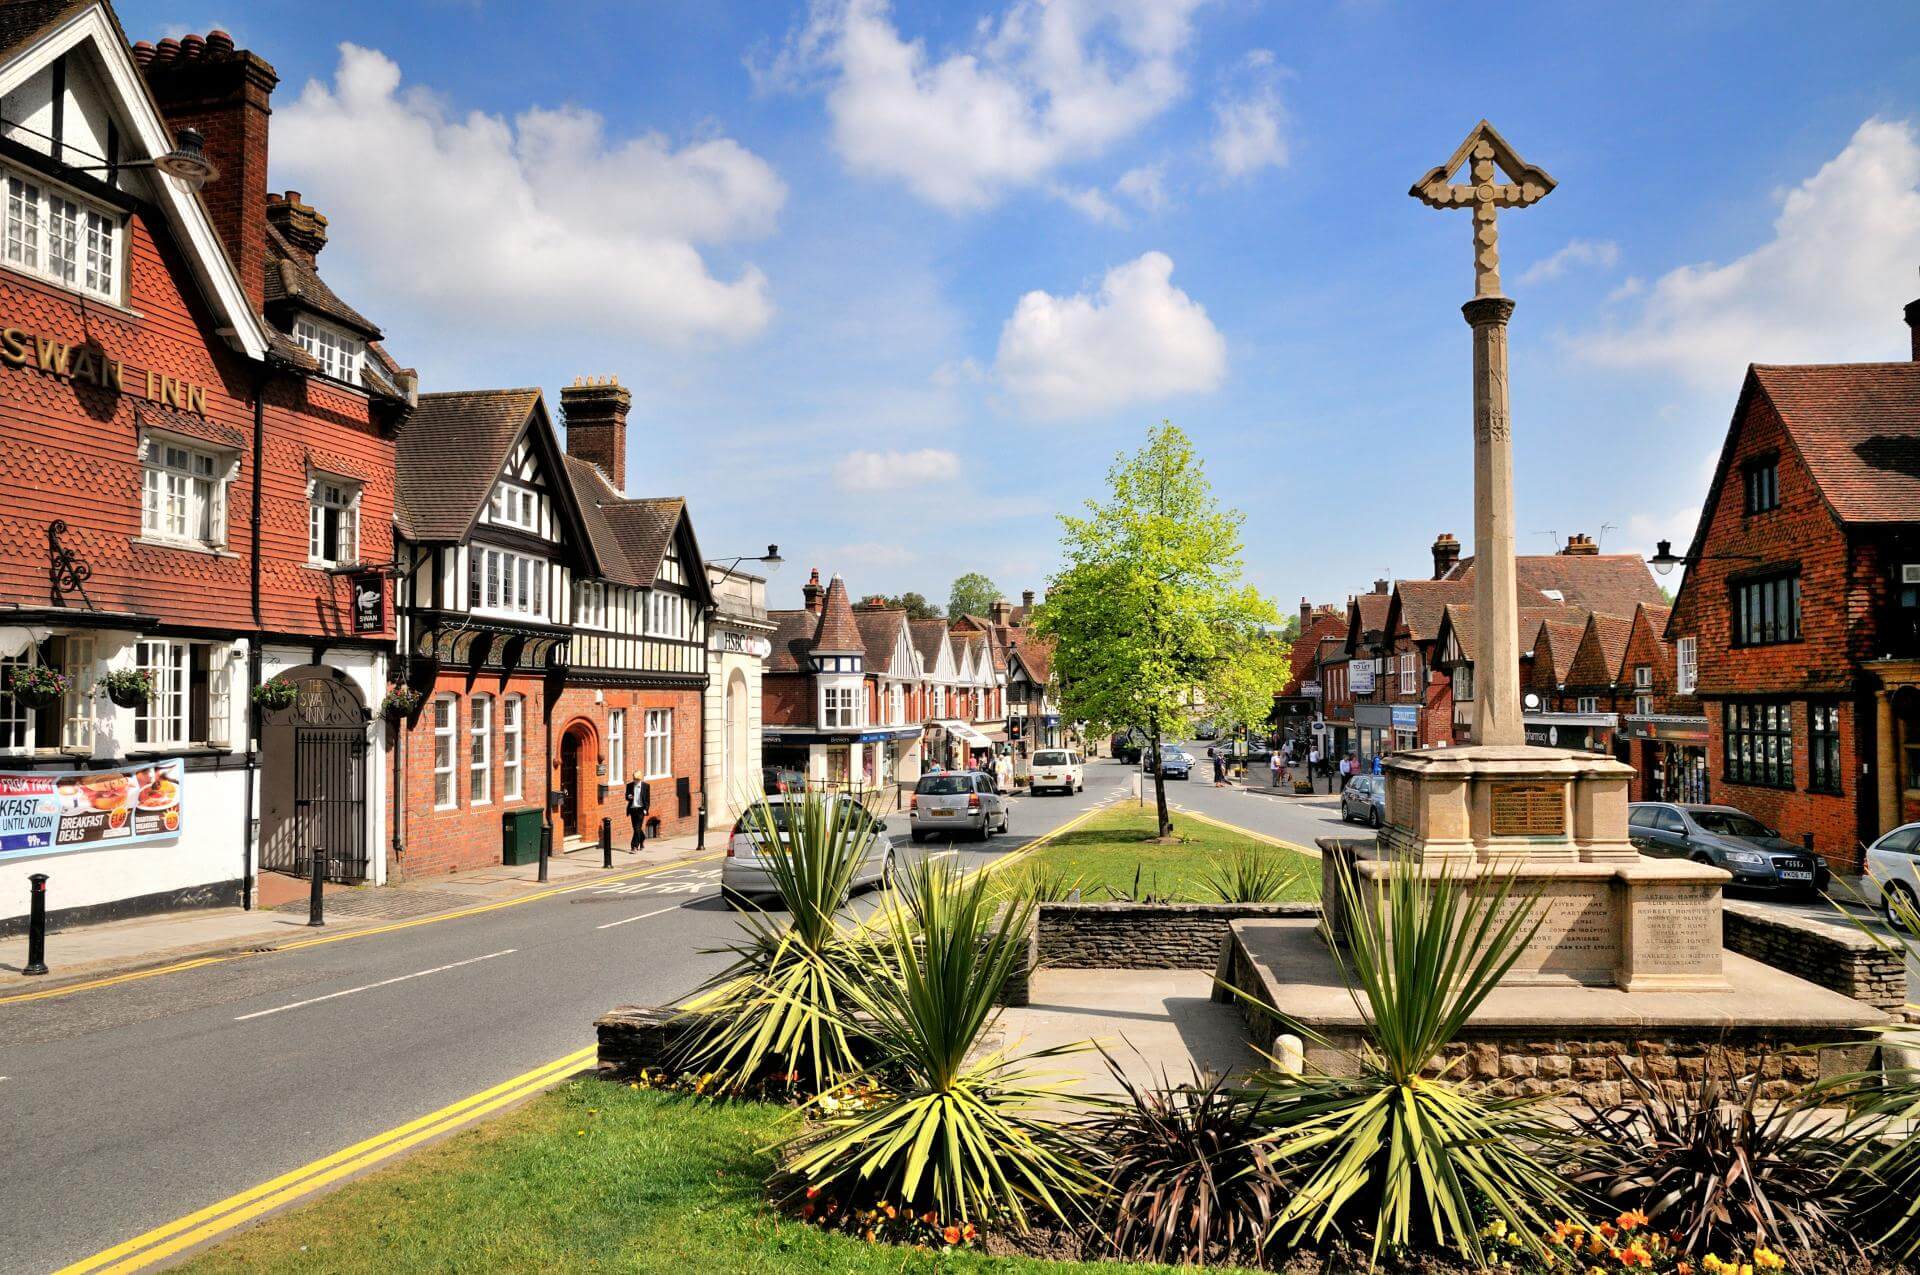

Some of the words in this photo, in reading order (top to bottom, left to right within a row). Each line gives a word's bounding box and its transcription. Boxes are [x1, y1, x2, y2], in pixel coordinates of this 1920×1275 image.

[1, 327, 124, 392] SWAN
[147, 370, 207, 418] INN
[363, 622, 374, 630] INN
[724, 632, 746, 652] HSBC
[309, 680, 324, 693] THE
[306, 706, 325, 724] INN
[3, 817, 25, 831] UNTIL
[28, 816, 54, 829] NOON
[61, 815, 105, 830] BREAKFAST
[58, 829, 86, 842] DEALS
